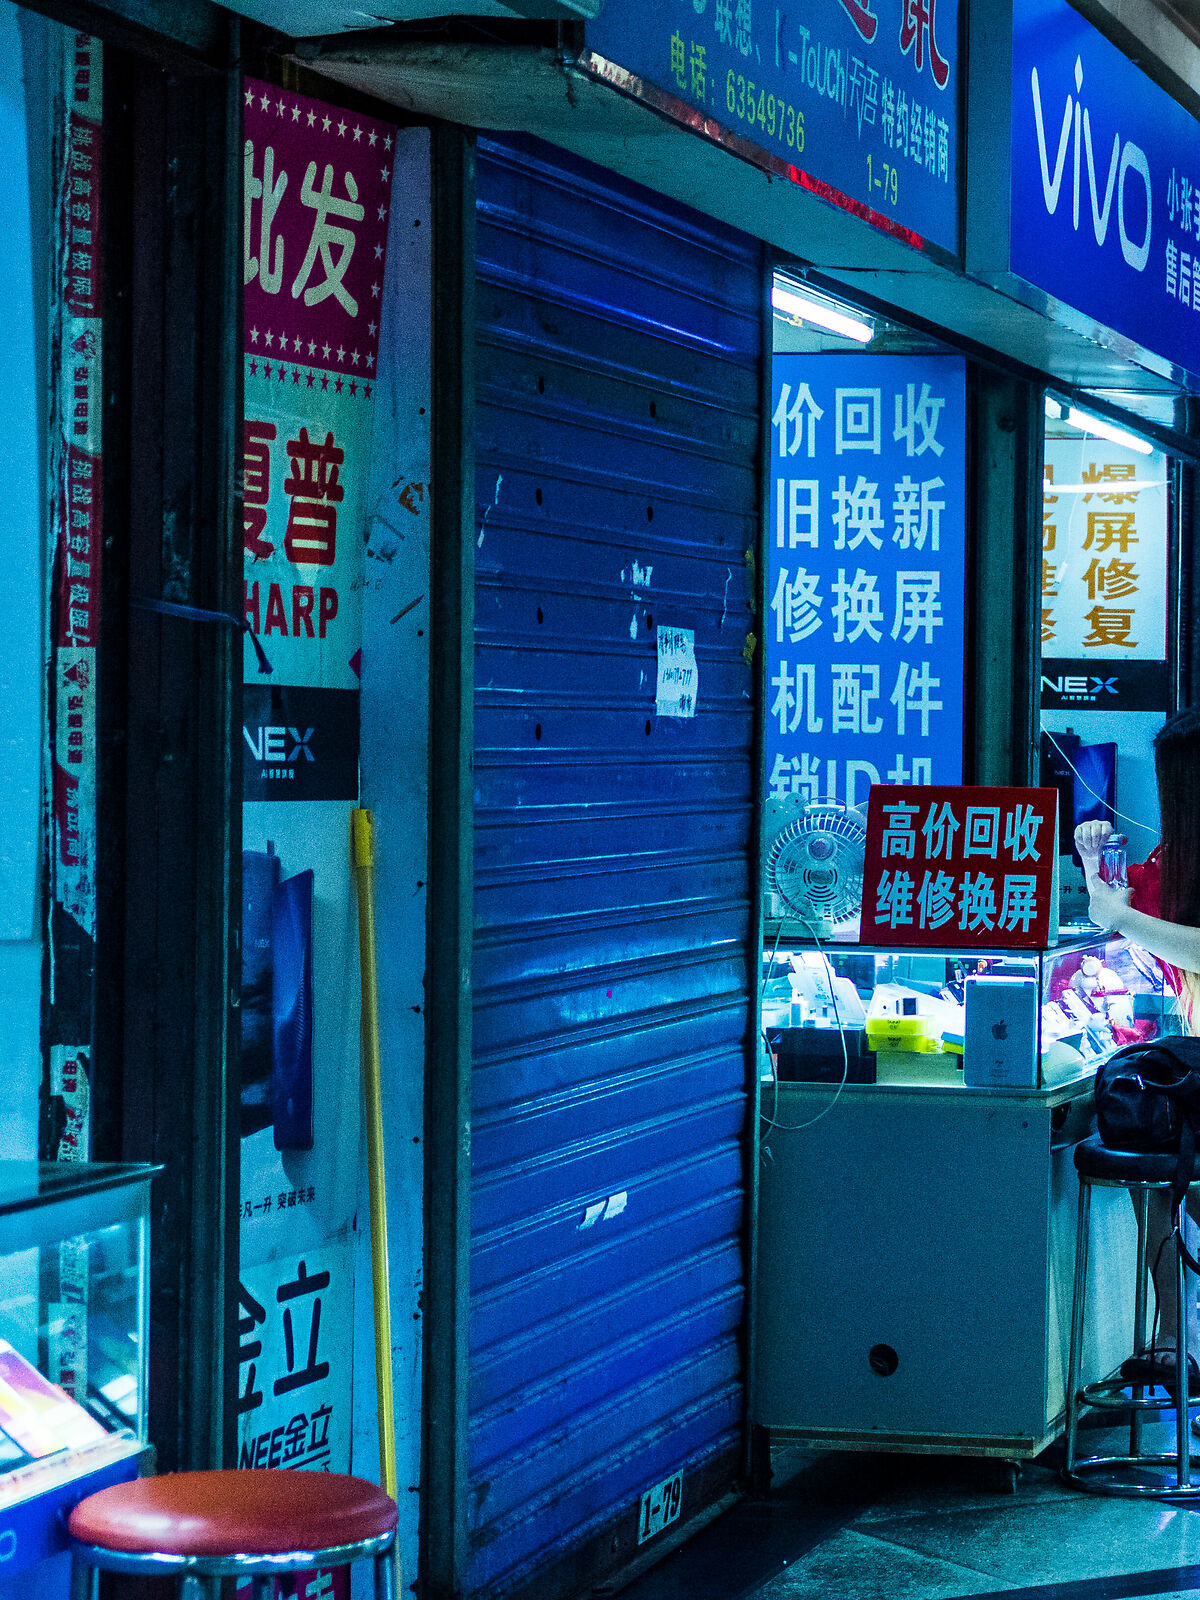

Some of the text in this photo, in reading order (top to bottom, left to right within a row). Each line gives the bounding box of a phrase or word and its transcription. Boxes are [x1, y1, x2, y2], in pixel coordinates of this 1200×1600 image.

[726, 69, 805, 152] 63549736
[866, 154, 898, 205] 1-79
[1031, 54, 1152, 272] vivo
[772, 383, 945, 458] 价回收
[776, 475, 945, 552] 旧换新
[1081, 462, 1140, 648] 爆屏修复
[770, 567, 944, 644] 修换屏
[770, 660, 943, 737] 机配件
[1040, 675, 1120, 694] NEX
[881, 800, 1044, 862] 高价回收
[874, 869, 1038, 933] 维修换屏
[641, 1476, 681, 1538] 1-79
